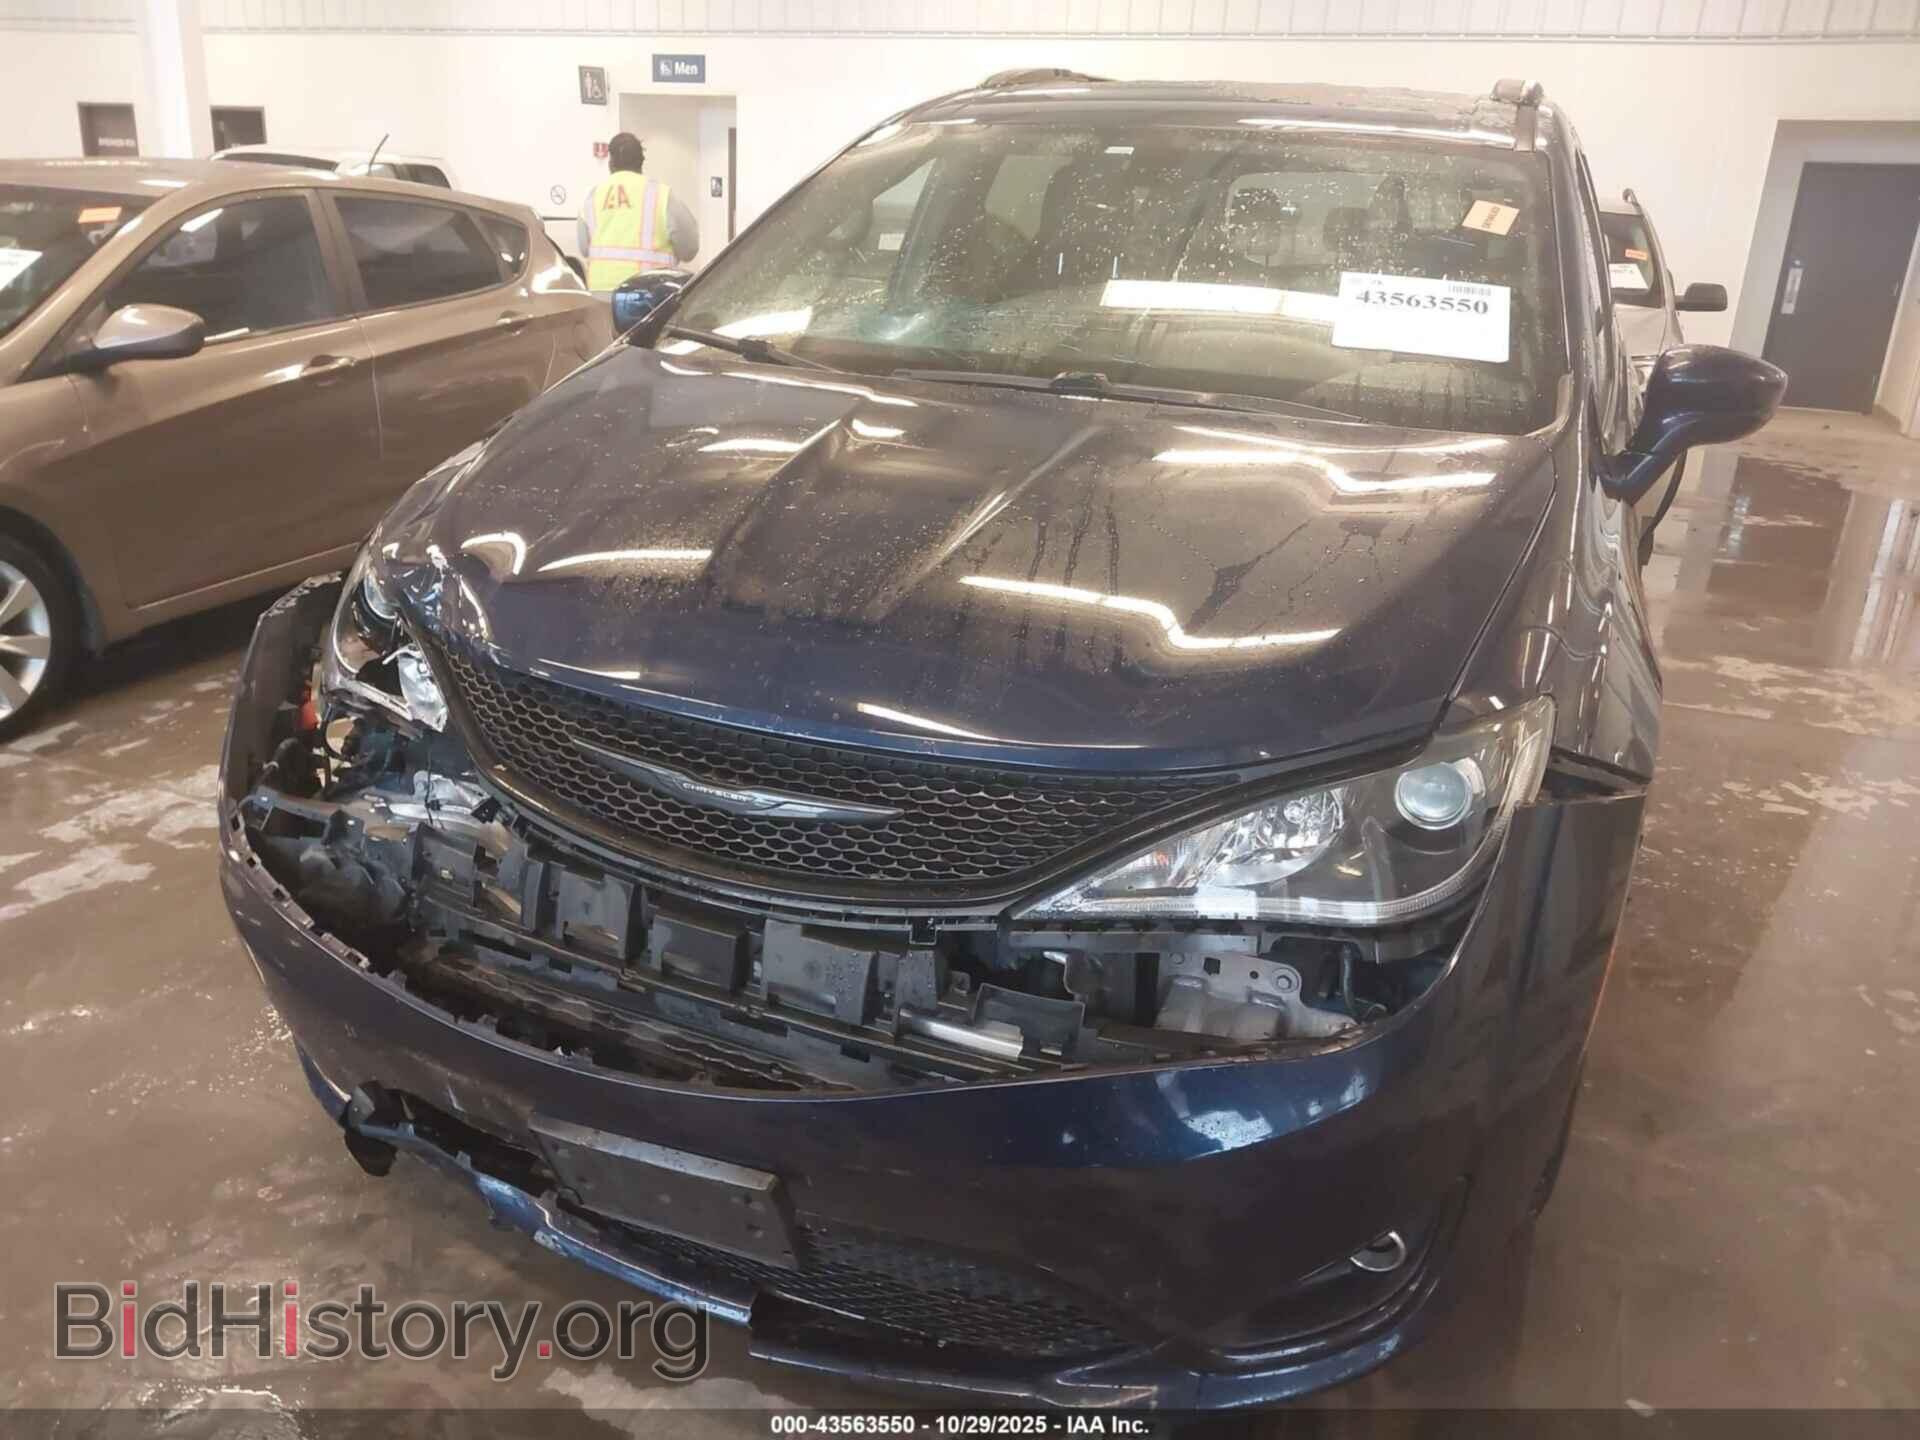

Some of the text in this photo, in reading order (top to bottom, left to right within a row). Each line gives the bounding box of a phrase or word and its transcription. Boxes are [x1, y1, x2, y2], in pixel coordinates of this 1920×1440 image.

[674, 61, 698, 75] Men
[1355, 289, 1489, 315] 43563550
[682, 782, 749, 803] CHRYSLER
